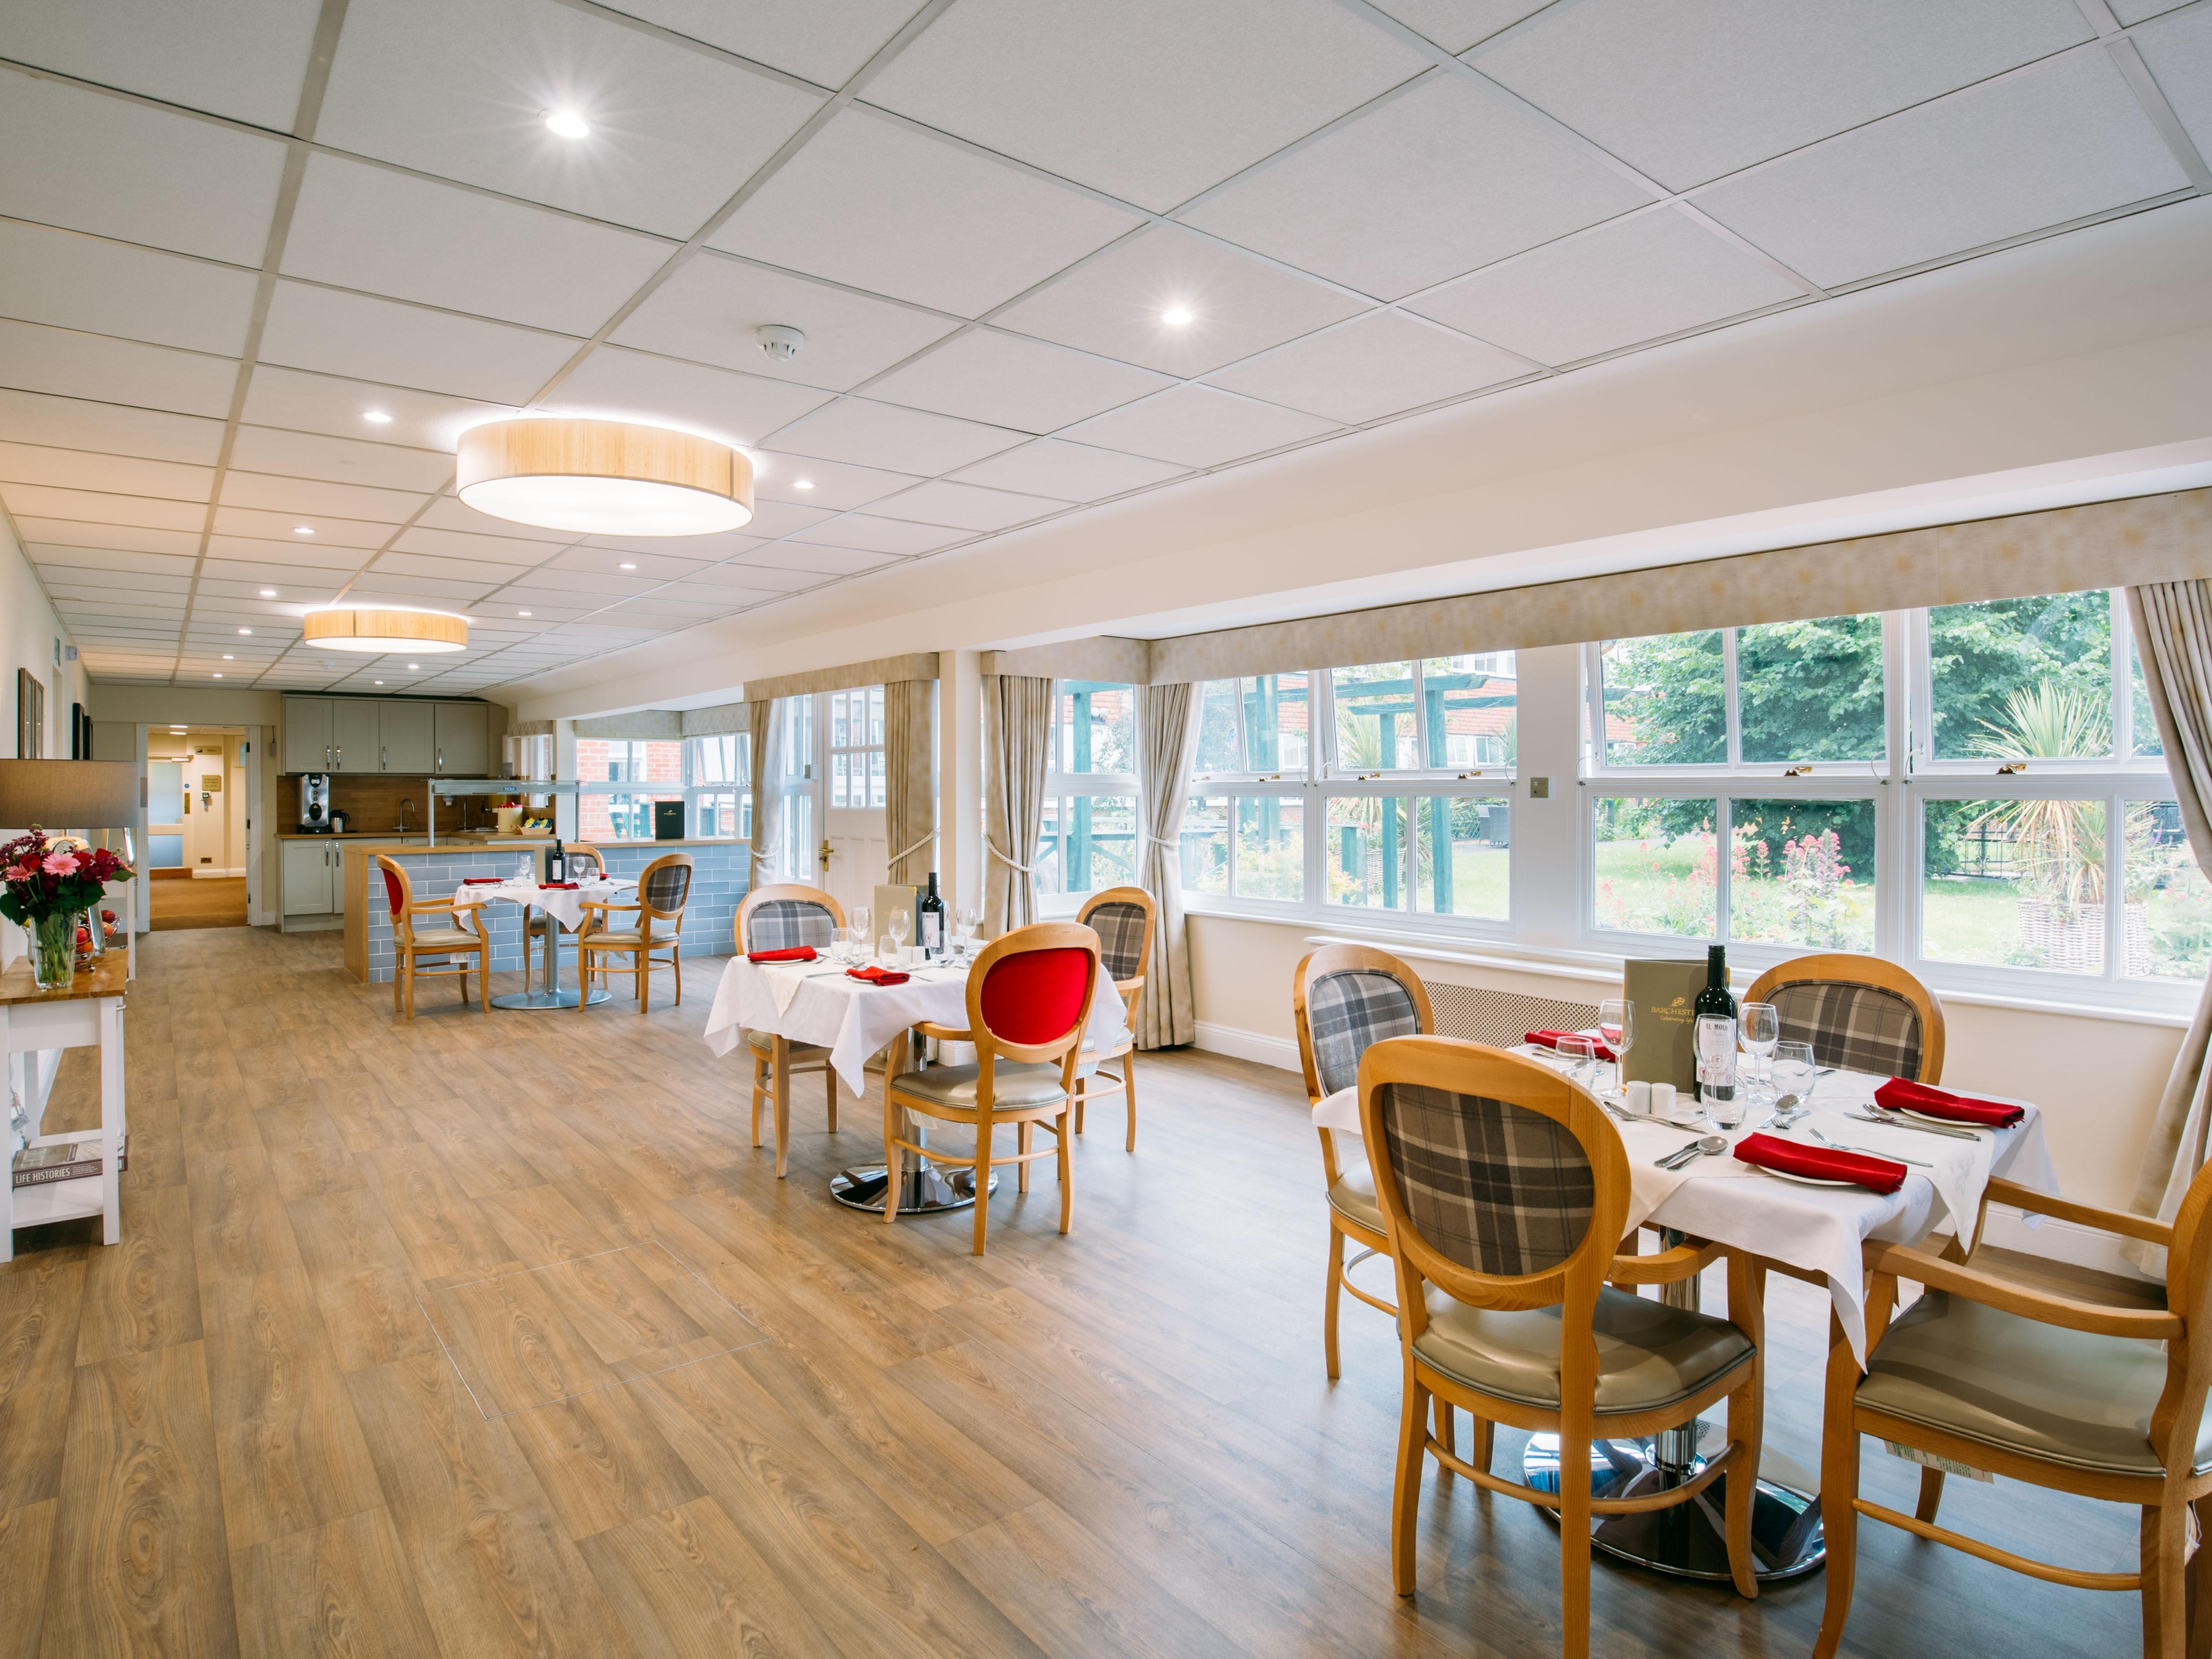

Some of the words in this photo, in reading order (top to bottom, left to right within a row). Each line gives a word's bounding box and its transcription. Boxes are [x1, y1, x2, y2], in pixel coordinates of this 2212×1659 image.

[1650, 1006, 1695, 1016] BARCHESTE
[15, 1173, 31, 1184] LIFE
[33, 1167, 70, 1182] HISTORIES
